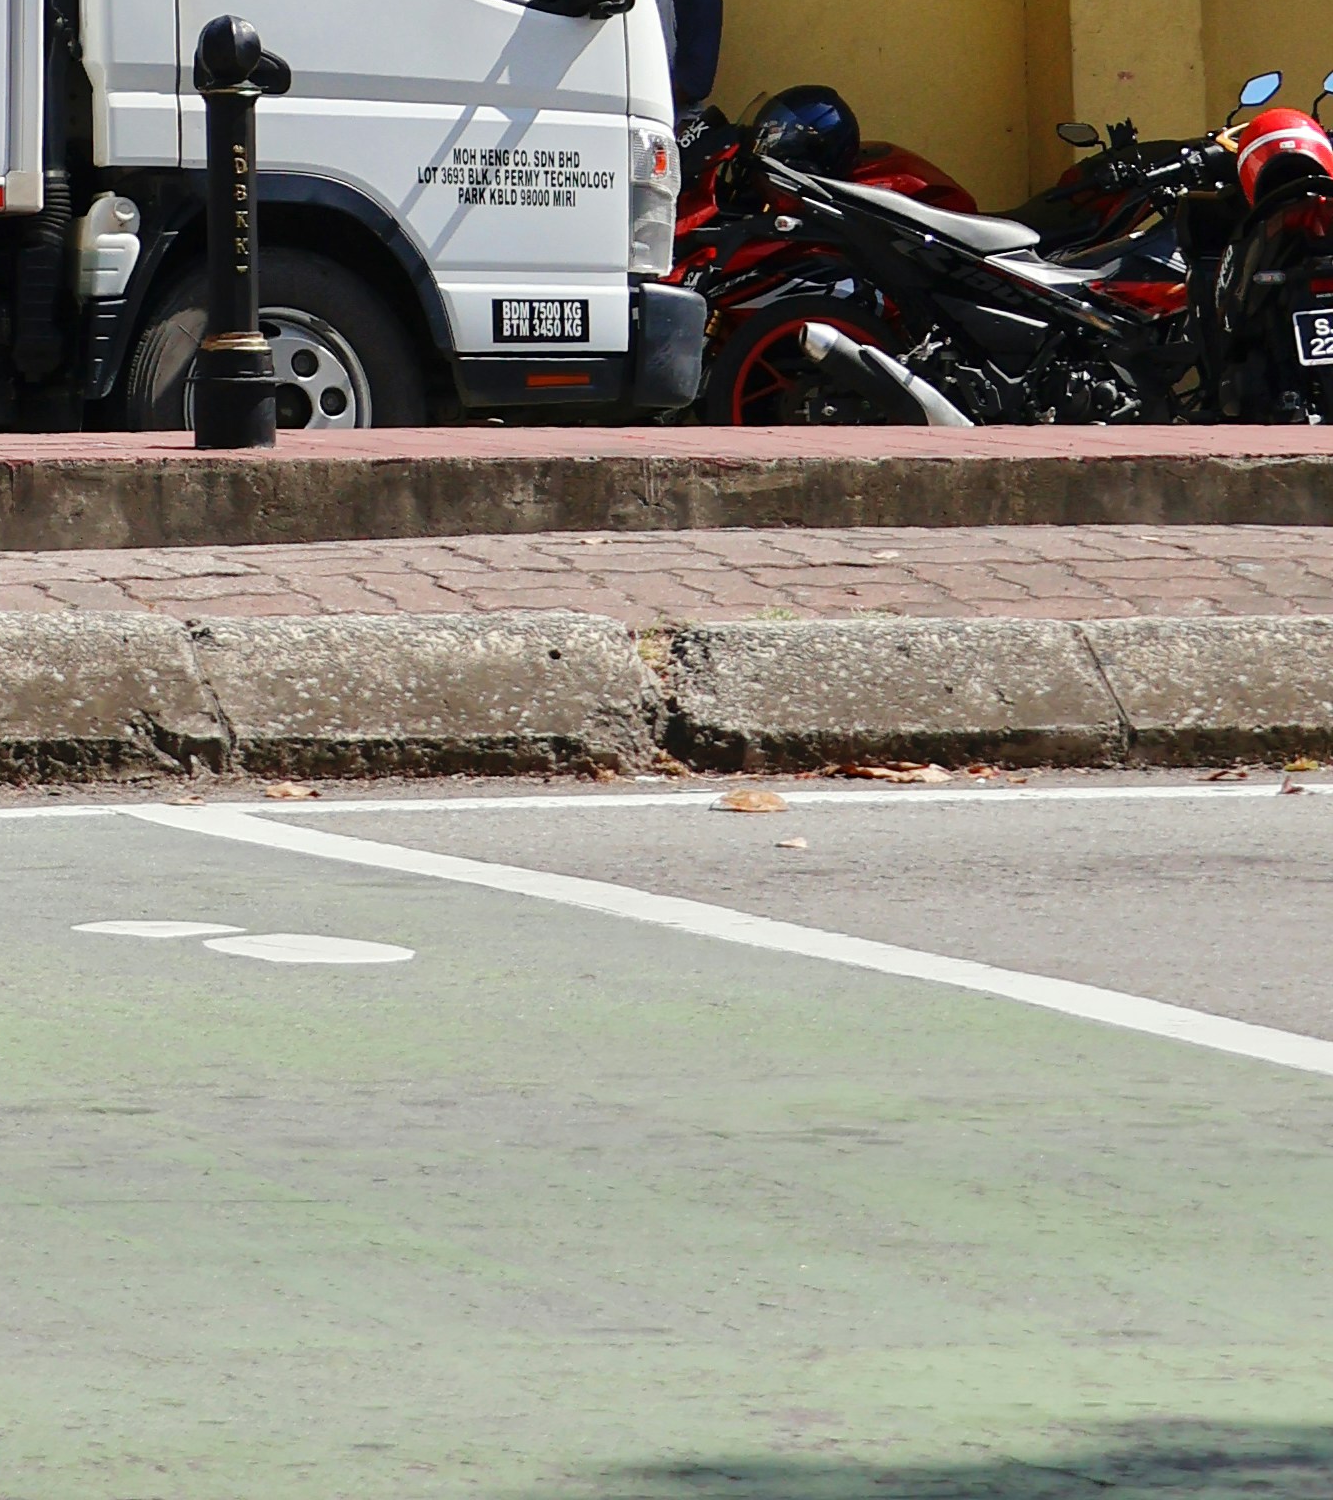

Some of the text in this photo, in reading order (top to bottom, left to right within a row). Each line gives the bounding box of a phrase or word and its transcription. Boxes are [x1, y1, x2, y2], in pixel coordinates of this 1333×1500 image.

[453, 147, 580, 169] MOH HENG CO. SDN BHD
[417, 166, 615, 190] LOT 3693 BLK. 6 PERMY TECHNOLOGY
[458, 186, 576, 207] PARK KBLD 98000 MIRI
[502, 301, 582, 319] BDM 7500 KG
[503, 319, 582, 337] BTM 3450 KG
